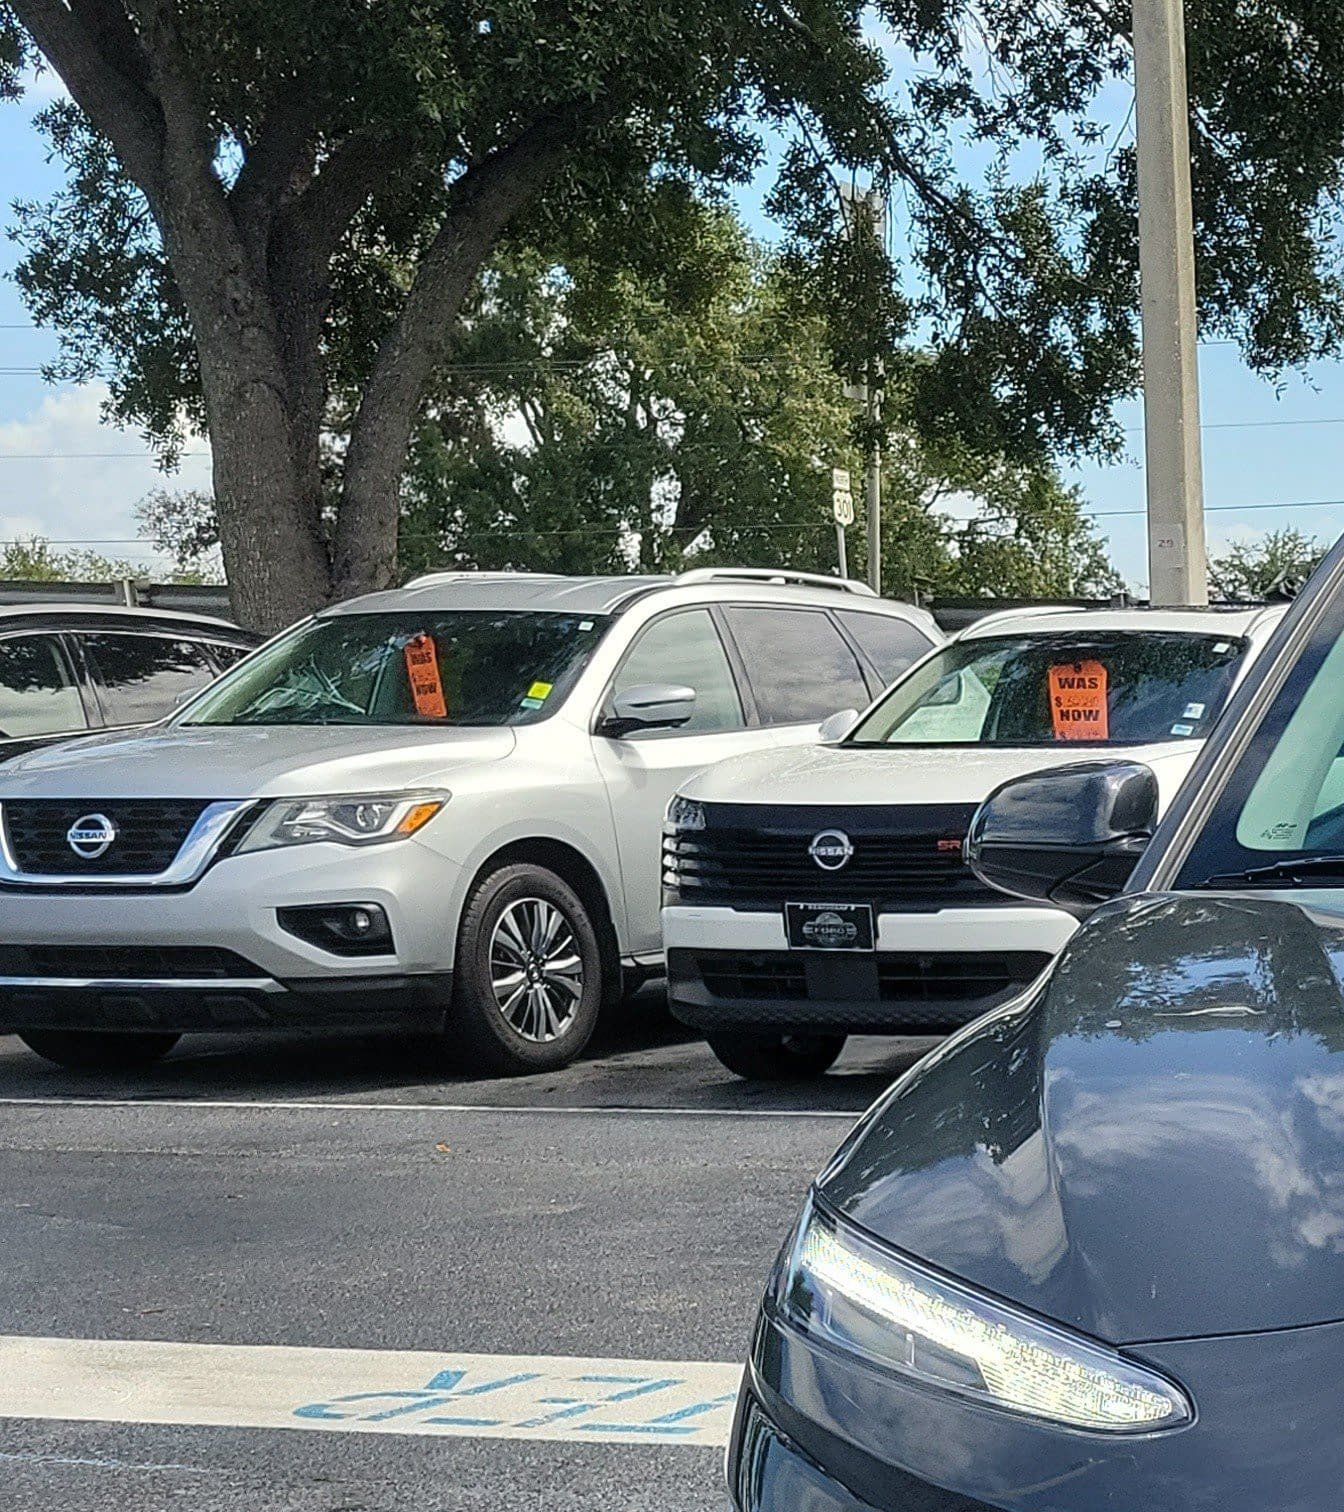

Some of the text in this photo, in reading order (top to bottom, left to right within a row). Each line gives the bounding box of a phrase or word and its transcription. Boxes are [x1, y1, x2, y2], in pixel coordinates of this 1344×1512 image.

[1058, 677, 1099, 690] WAS
[1060, 709, 1100, 722] NOW
[808, 845, 854, 856] NISSAN
[937, 839, 961, 851] SR
